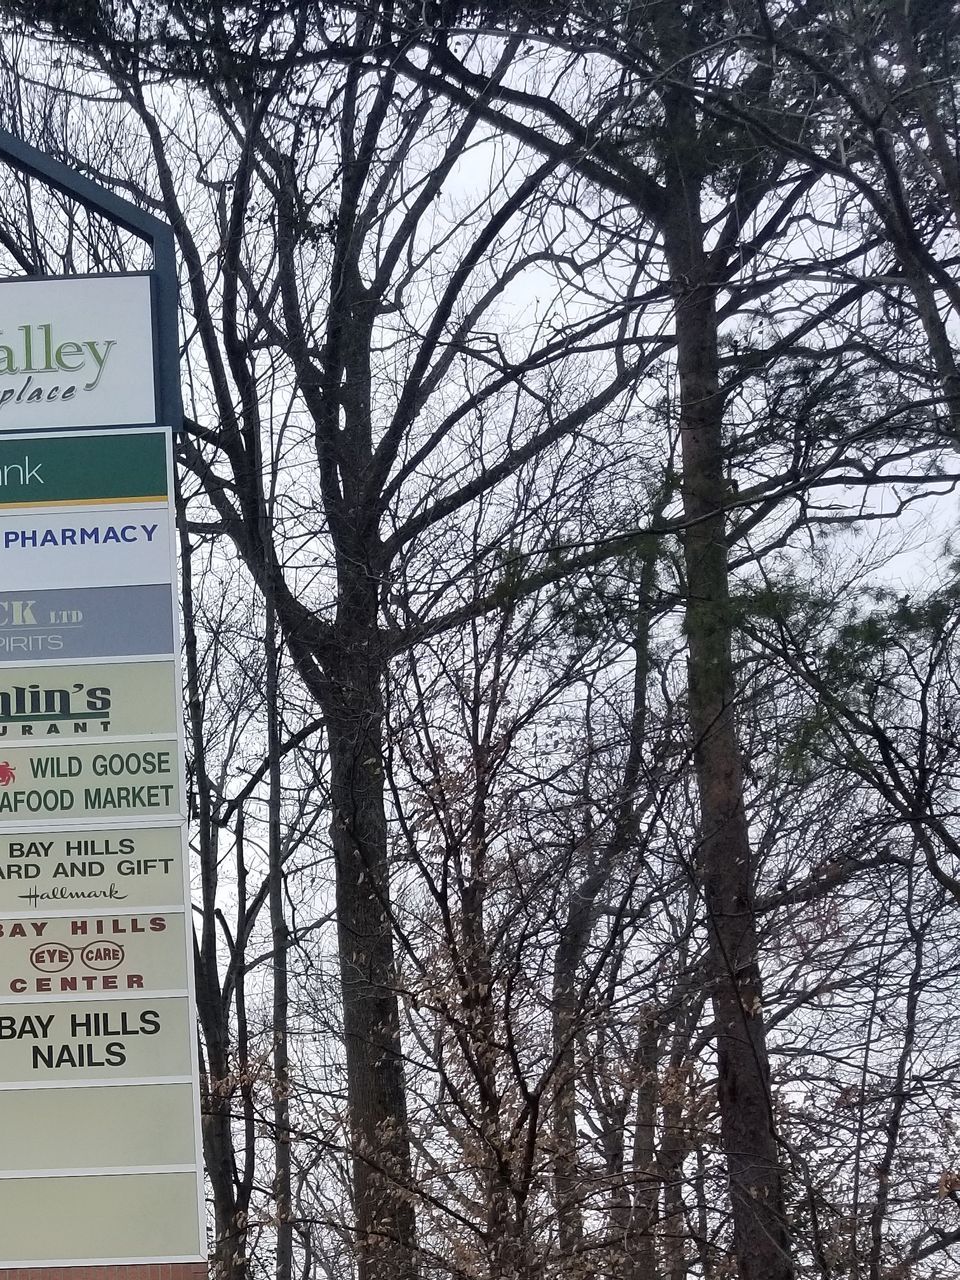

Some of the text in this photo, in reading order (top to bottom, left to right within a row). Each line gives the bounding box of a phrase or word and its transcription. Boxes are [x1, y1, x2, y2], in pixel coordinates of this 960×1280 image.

[5, 524, 158, 548] PHARMACY
[49, 609, 83, 624] LTD
[30, 752, 170, 778] WILD GOOSE
[84, 785, 173, 809] MARKET
[9, 839, 135, 858] BAY HILLS
[53, 861, 105, 878] AND
[116, 859, 174, 875] GIFT
[18, 883, 128, 908] Hallmark
[71, 917, 166, 935] HILLS
[34, 945, 120, 964] EYE CARE
[10, 975, 144, 993] CENTER
[70, 1011, 161, 1038] HILLS
[32, 1042, 127, 1069] NAILS
